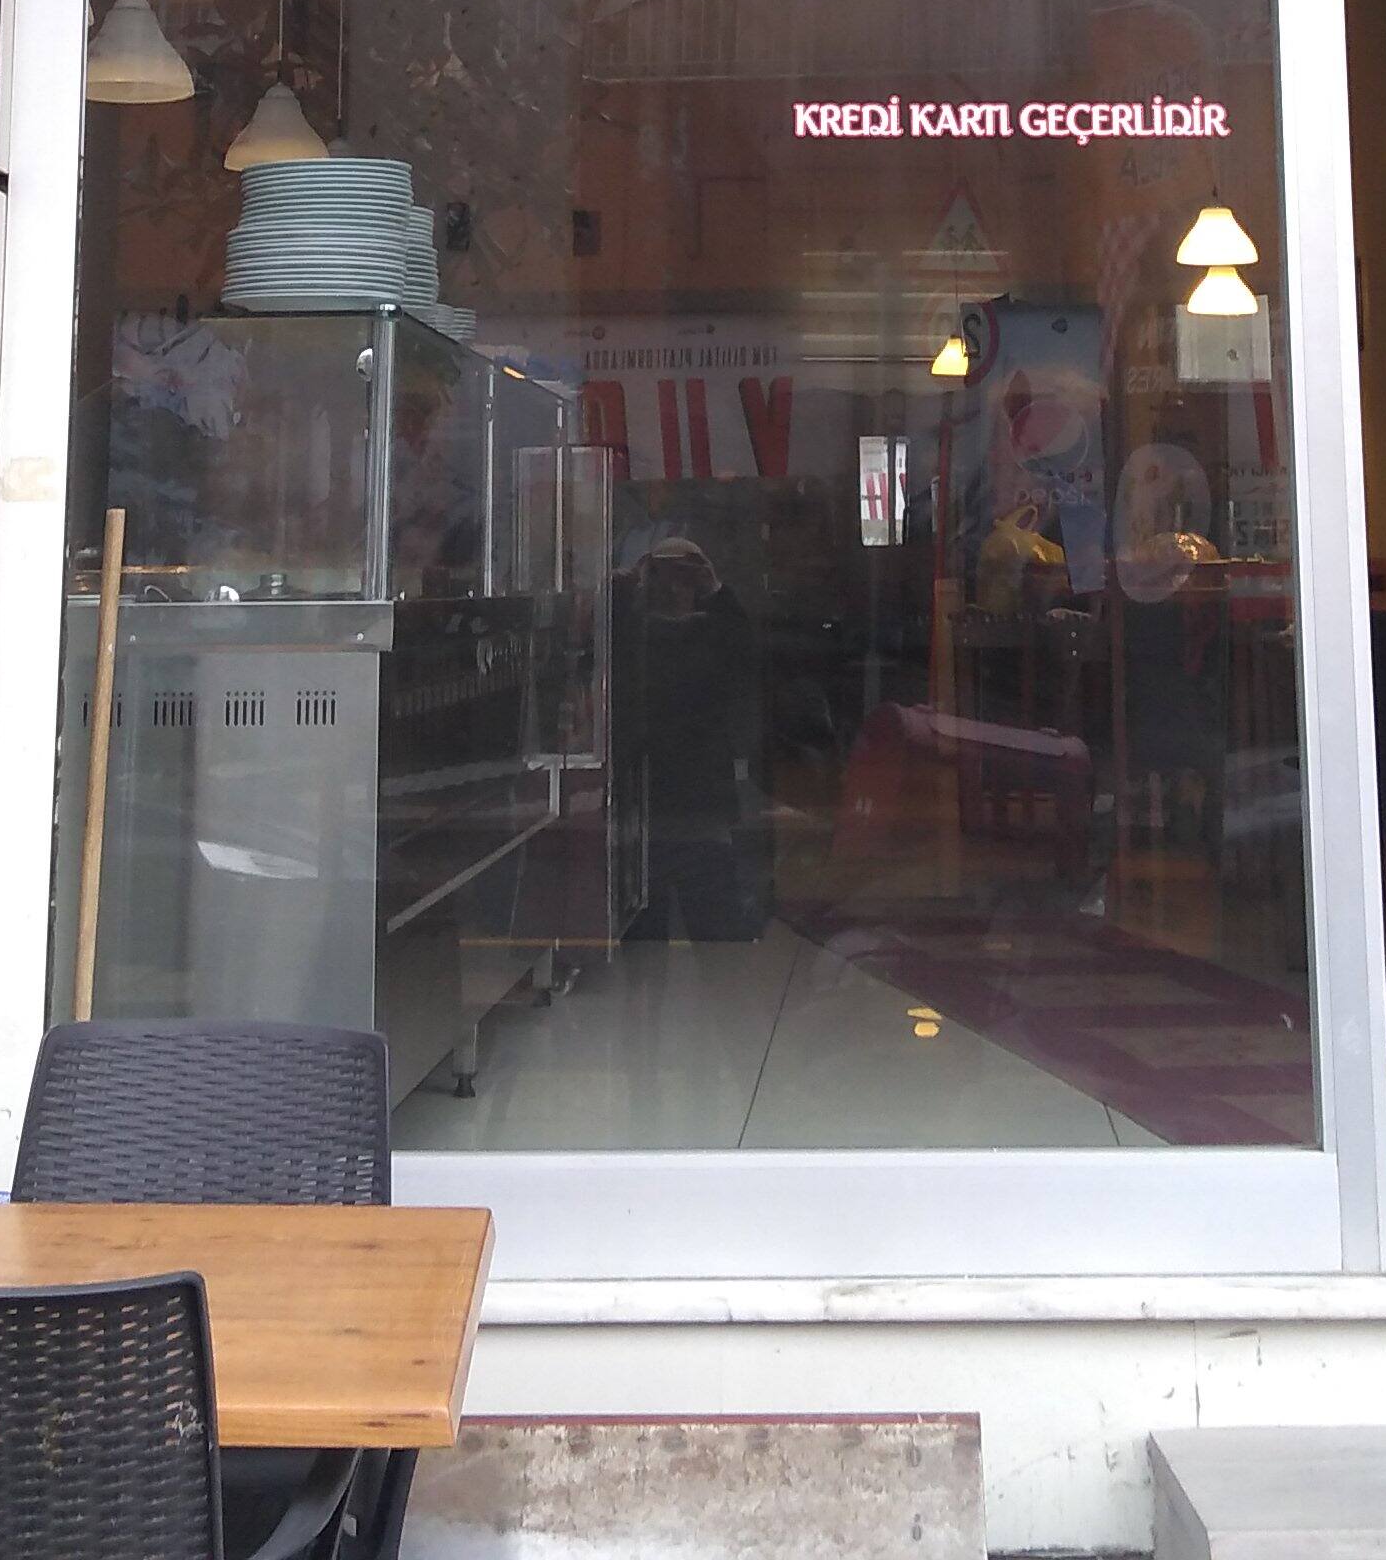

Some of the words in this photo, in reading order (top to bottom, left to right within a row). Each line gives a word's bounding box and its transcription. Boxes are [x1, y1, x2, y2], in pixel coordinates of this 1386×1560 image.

[794, 94, 904, 138] KREDİ
[909, 102, 1014, 138] KARTI
[1019, 95, 1232, 146] GEÇERLİDİR
